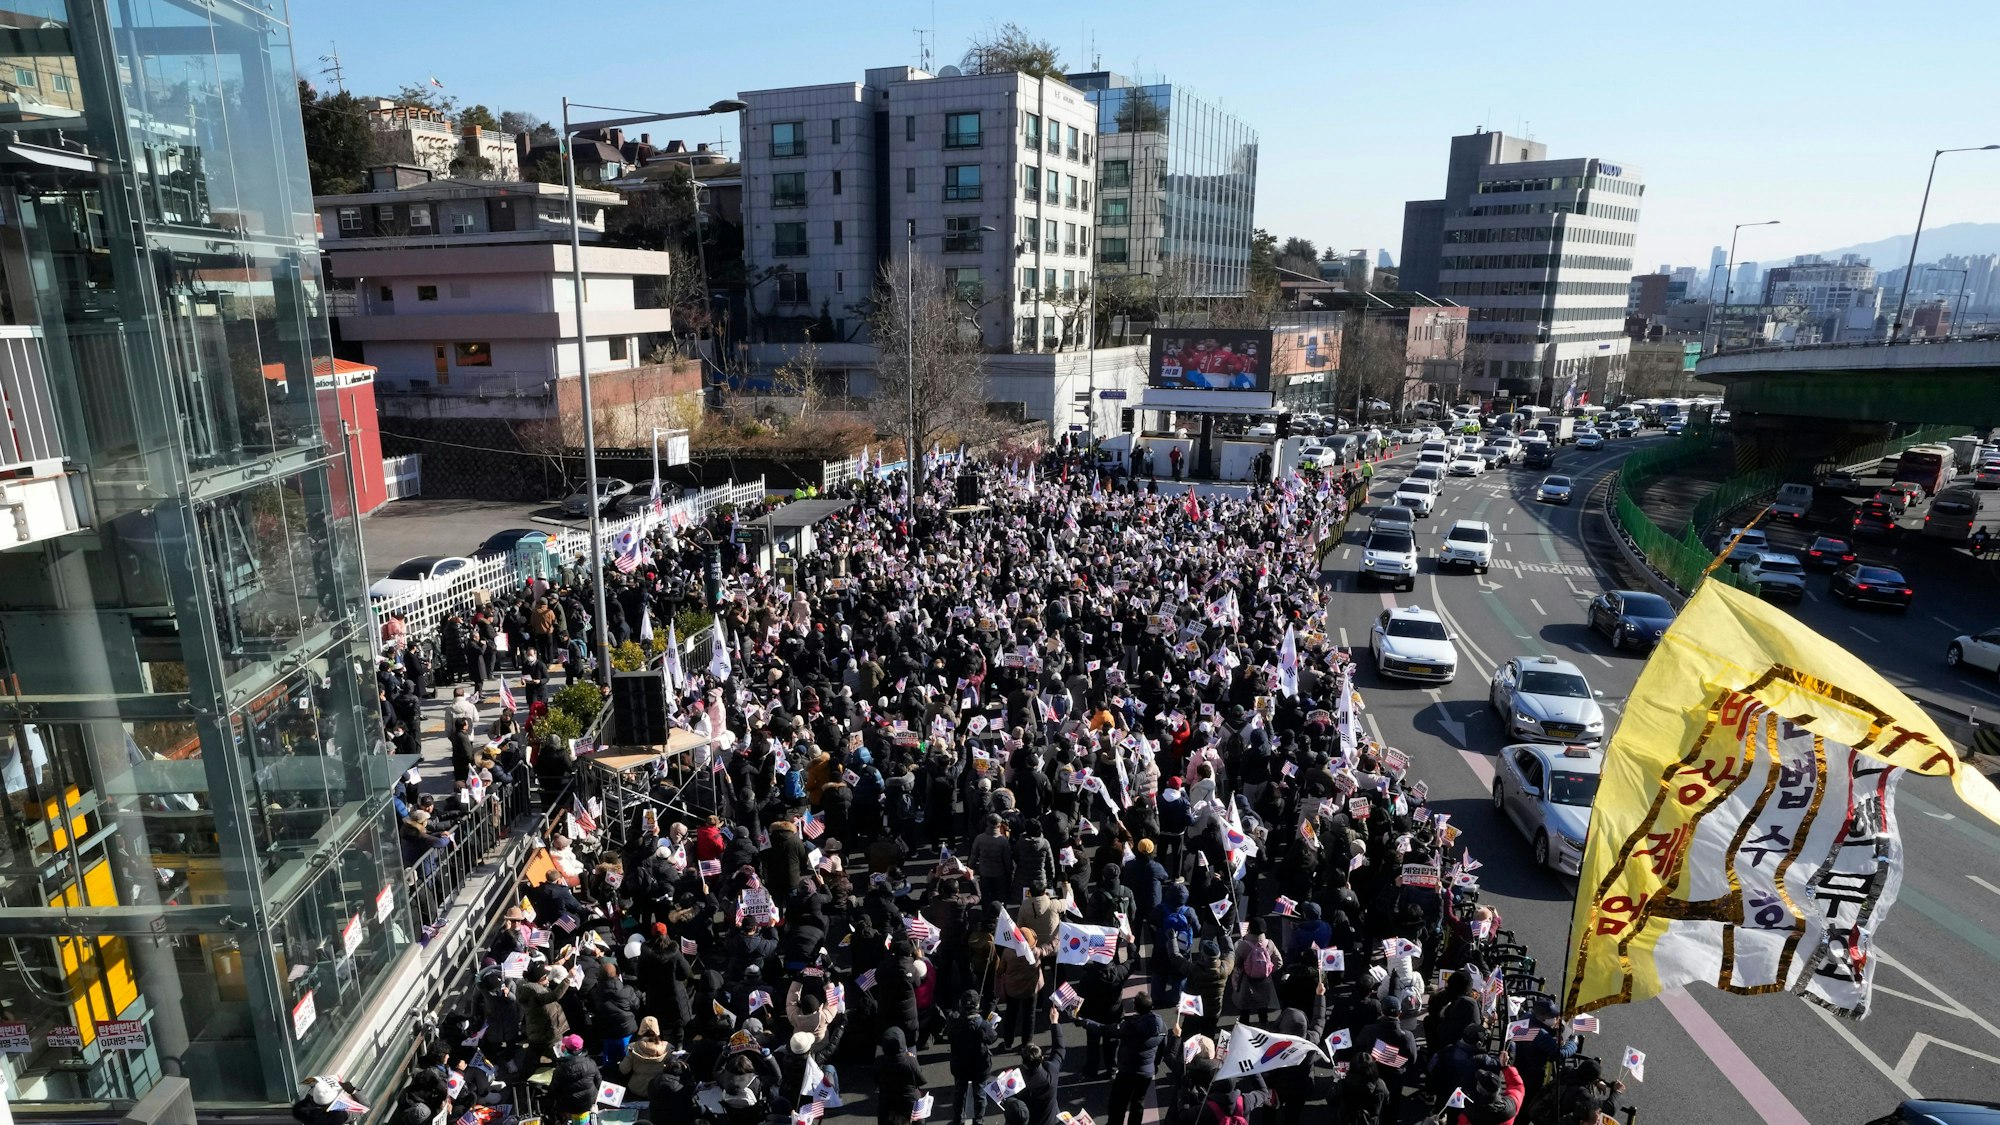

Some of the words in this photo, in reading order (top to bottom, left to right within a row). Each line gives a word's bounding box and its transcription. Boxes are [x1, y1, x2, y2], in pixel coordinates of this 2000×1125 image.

[1598, 163, 1622, 177] VOLVO
[98, 1022, 141, 1036] 탄핵반대
[12, 1037, 29, 1046] 구속
[101, 1037, 127, 1047] 이재명
[128, 1034, 145, 1044] 구속
